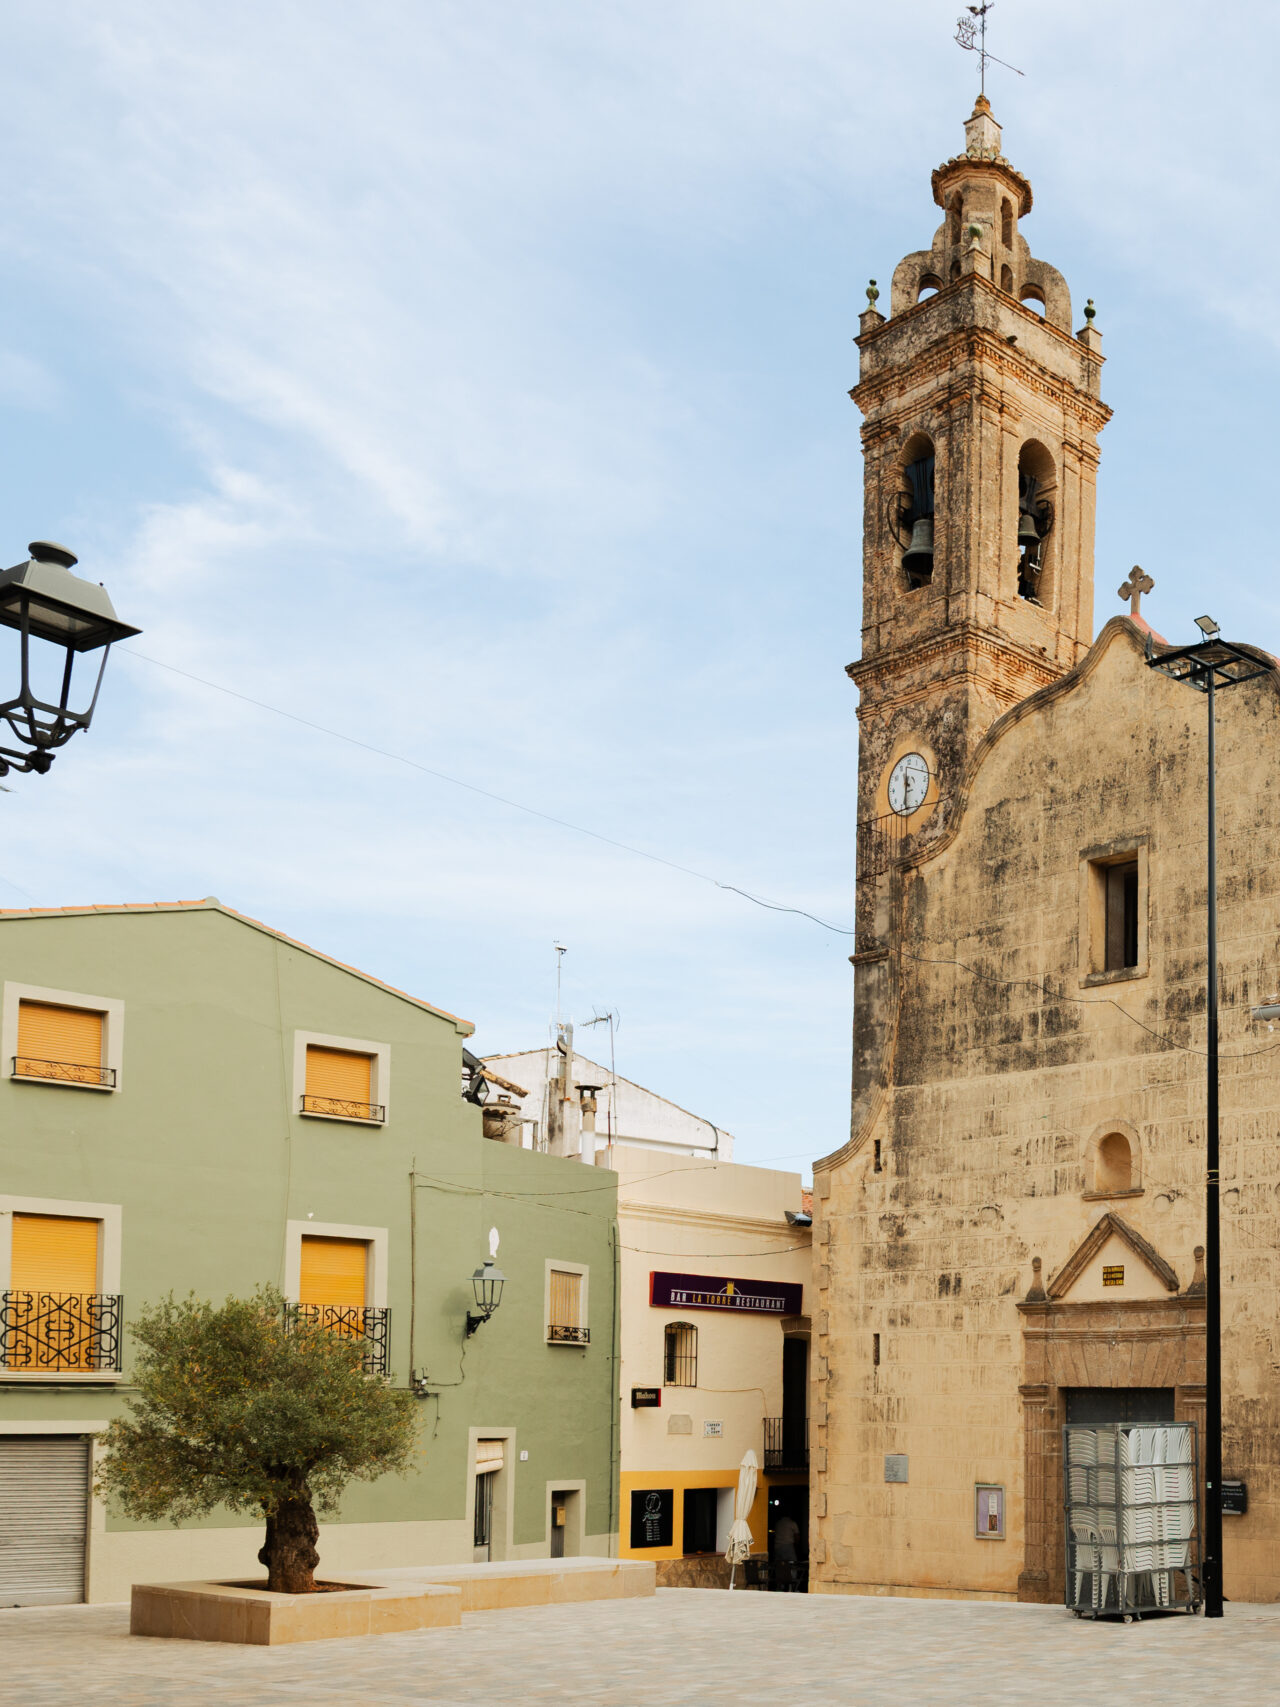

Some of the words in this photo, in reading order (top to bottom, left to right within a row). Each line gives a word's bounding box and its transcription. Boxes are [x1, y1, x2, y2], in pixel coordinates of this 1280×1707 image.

[670, 1291, 687, 1302] BAR
[692, 1294, 702, 1303] LA
[706, 1294, 732, 1305] TORRE
[735, 1297, 785, 1309] RESTAURANT
